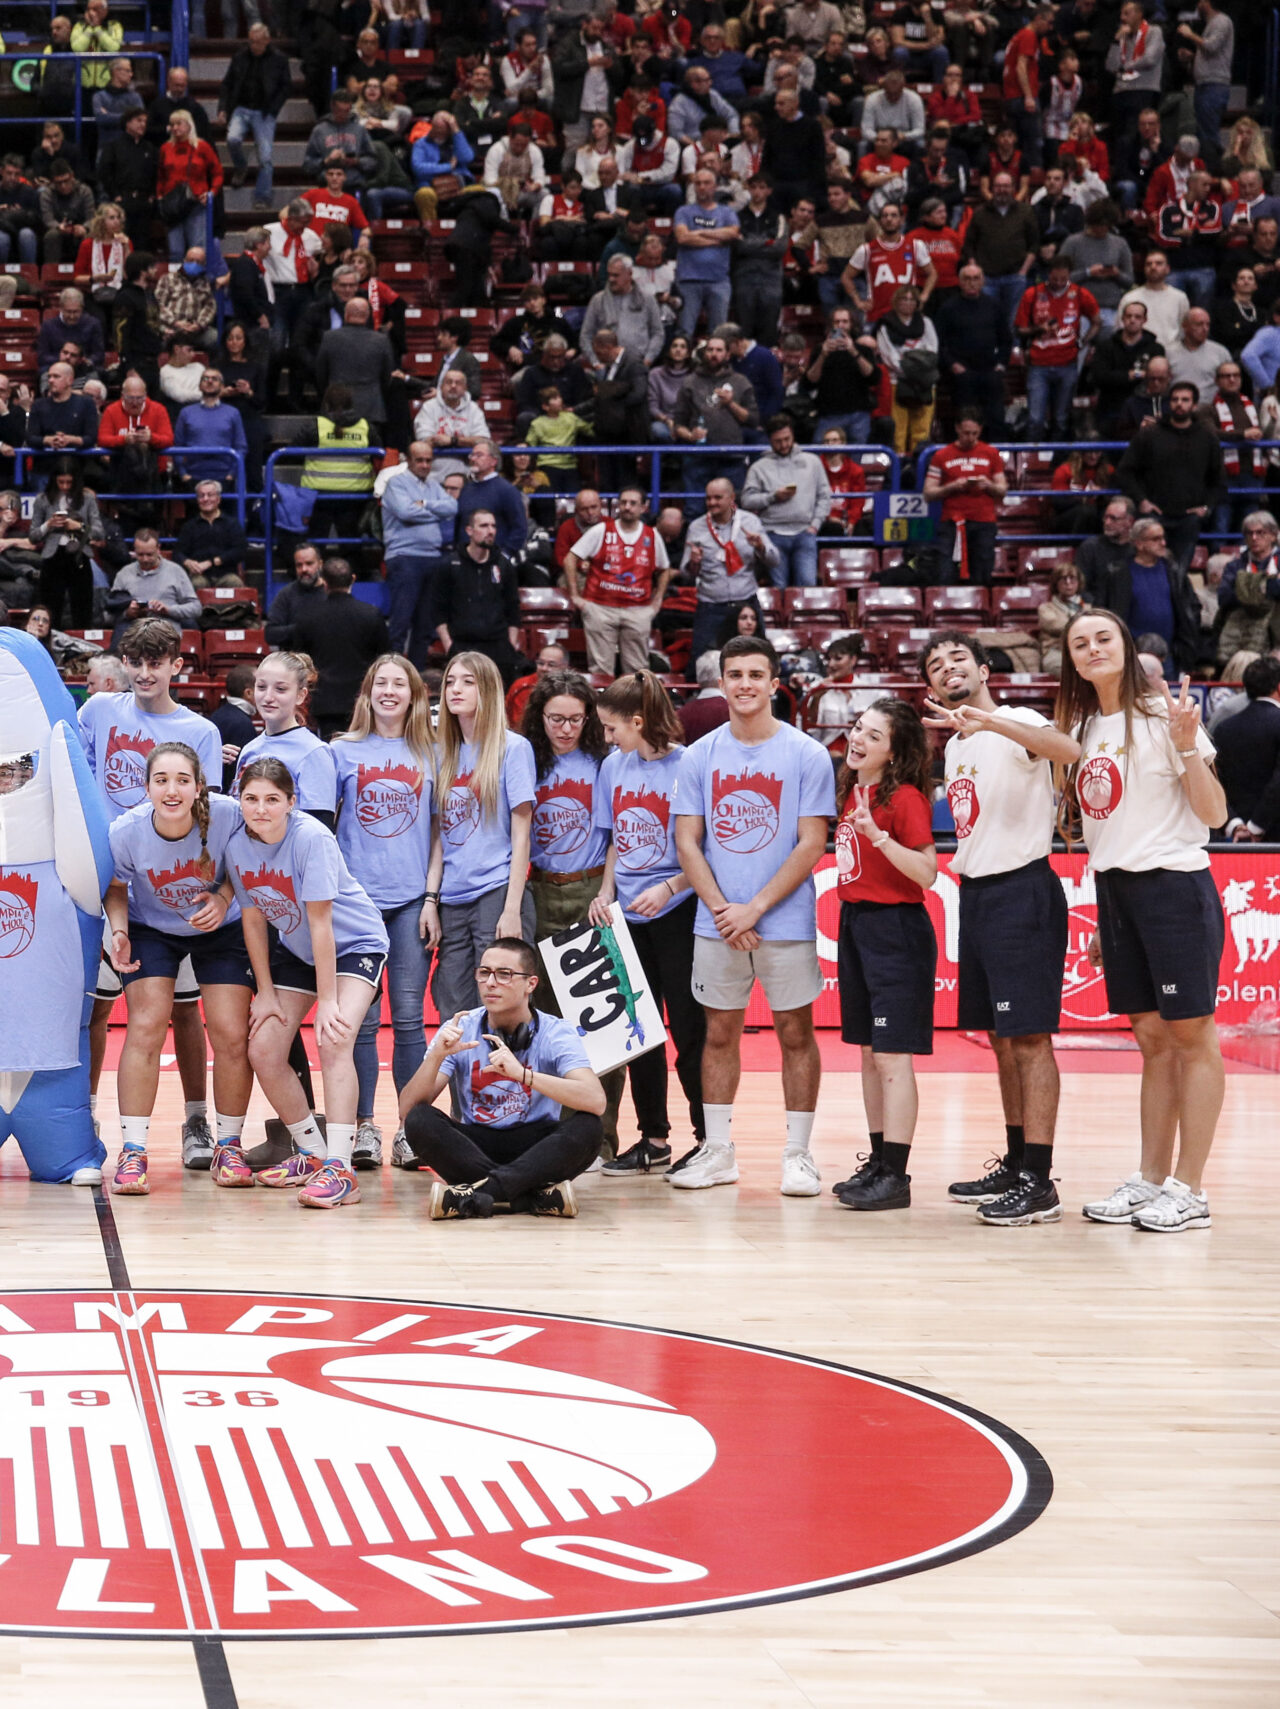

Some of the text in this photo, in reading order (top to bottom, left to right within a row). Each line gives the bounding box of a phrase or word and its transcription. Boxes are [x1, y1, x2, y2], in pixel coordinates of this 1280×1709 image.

[874, 263, 912, 287] AJ
[896, 497, 923, 515] 22
[605, 531, 618, 545] 31
[1084, 758, 1111, 773] OLIMPIA
[361, 790, 407, 804] OLIMPIA
[360, 802, 408, 822] SCHOOL
[717, 804, 765, 817] OLIMPIA
[534, 811, 578, 826] OLIMPIA
[616, 818, 654, 834] OLIMPIA
[536, 818, 581, 844] SCHOOL
[715, 816, 767, 838] SCHOOL
[1162, 984, 1177, 994] EA7
[997, 1001, 1011, 1011] EA7
[874, 1017, 887, 1026] EA7
[20, 1390, 279, 1407] 19 36
